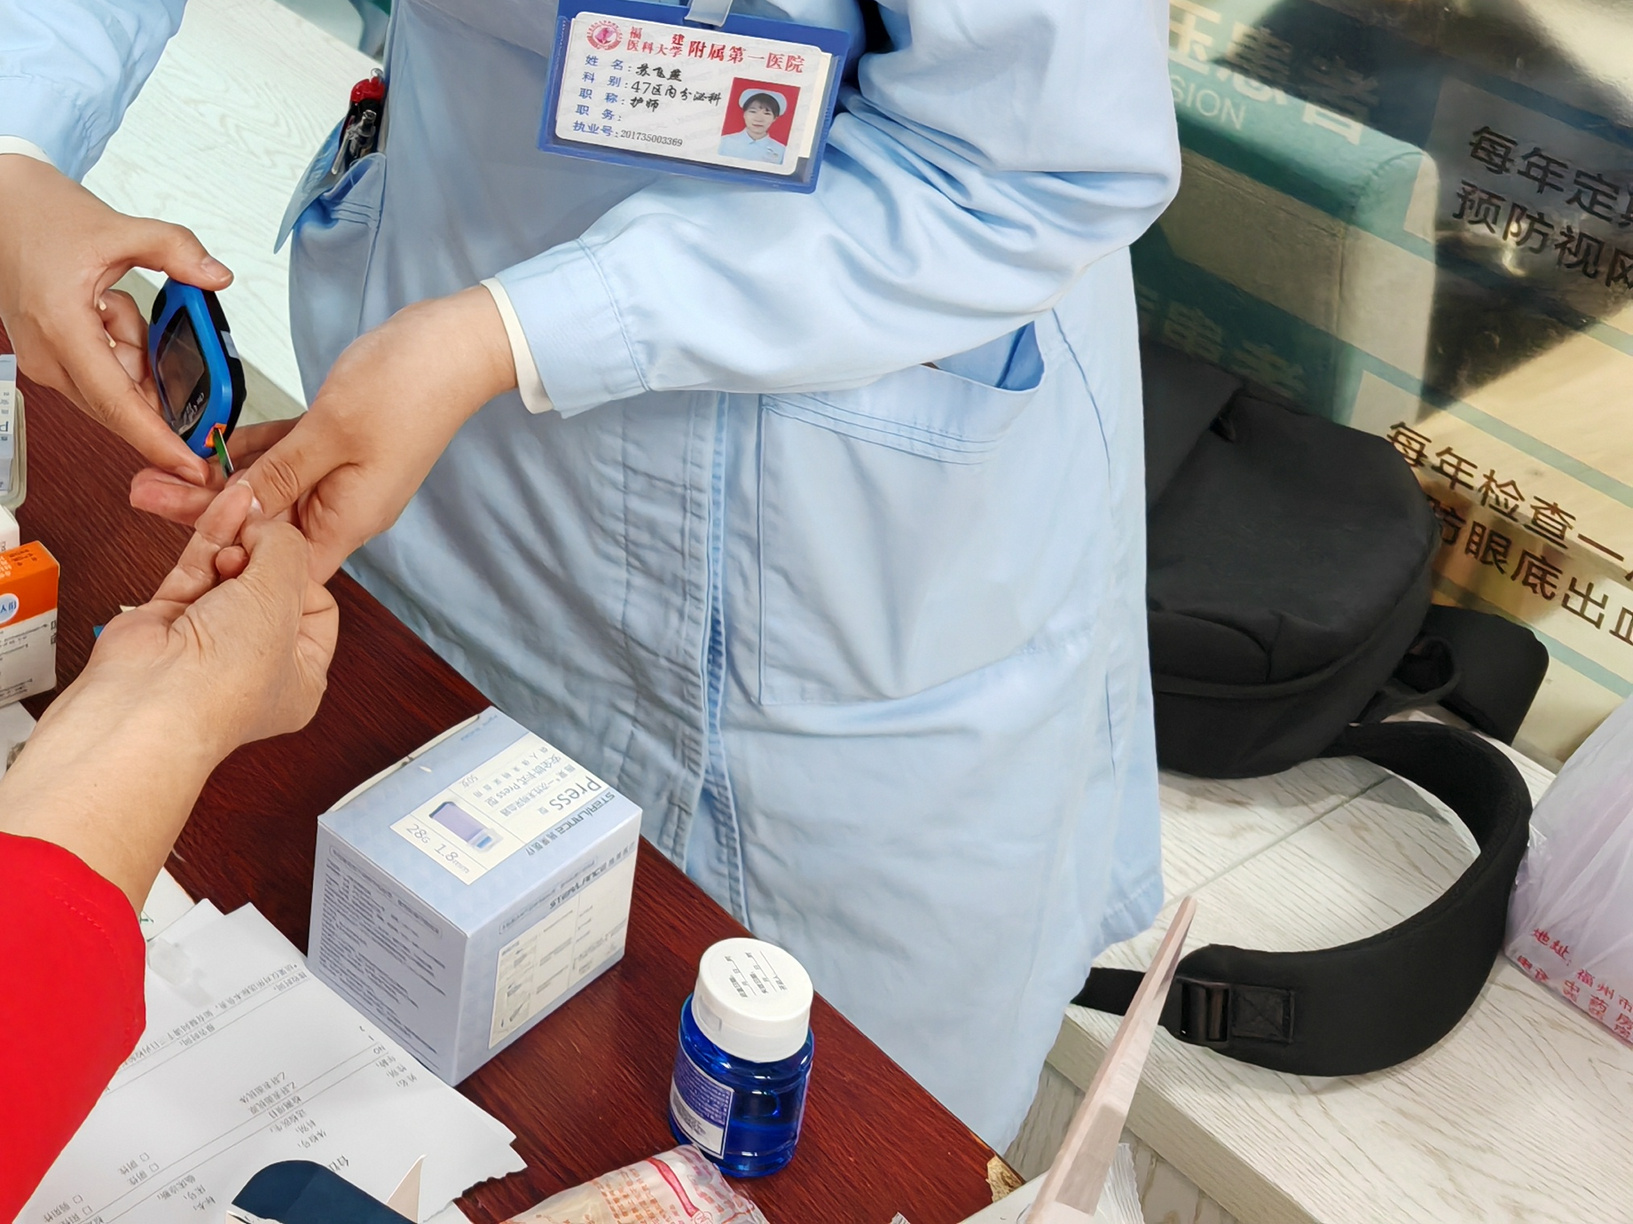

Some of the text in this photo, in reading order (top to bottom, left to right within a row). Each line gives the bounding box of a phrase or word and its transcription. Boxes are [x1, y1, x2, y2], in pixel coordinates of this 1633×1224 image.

[688, 41, 805, 74] 附属第一医院
[1386, 422, 1633, 582] 每年检查一
[496, 783, 520, 798] Press
[550, 777, 601, 810] Press
[406, 824, 430, 843] 28G
